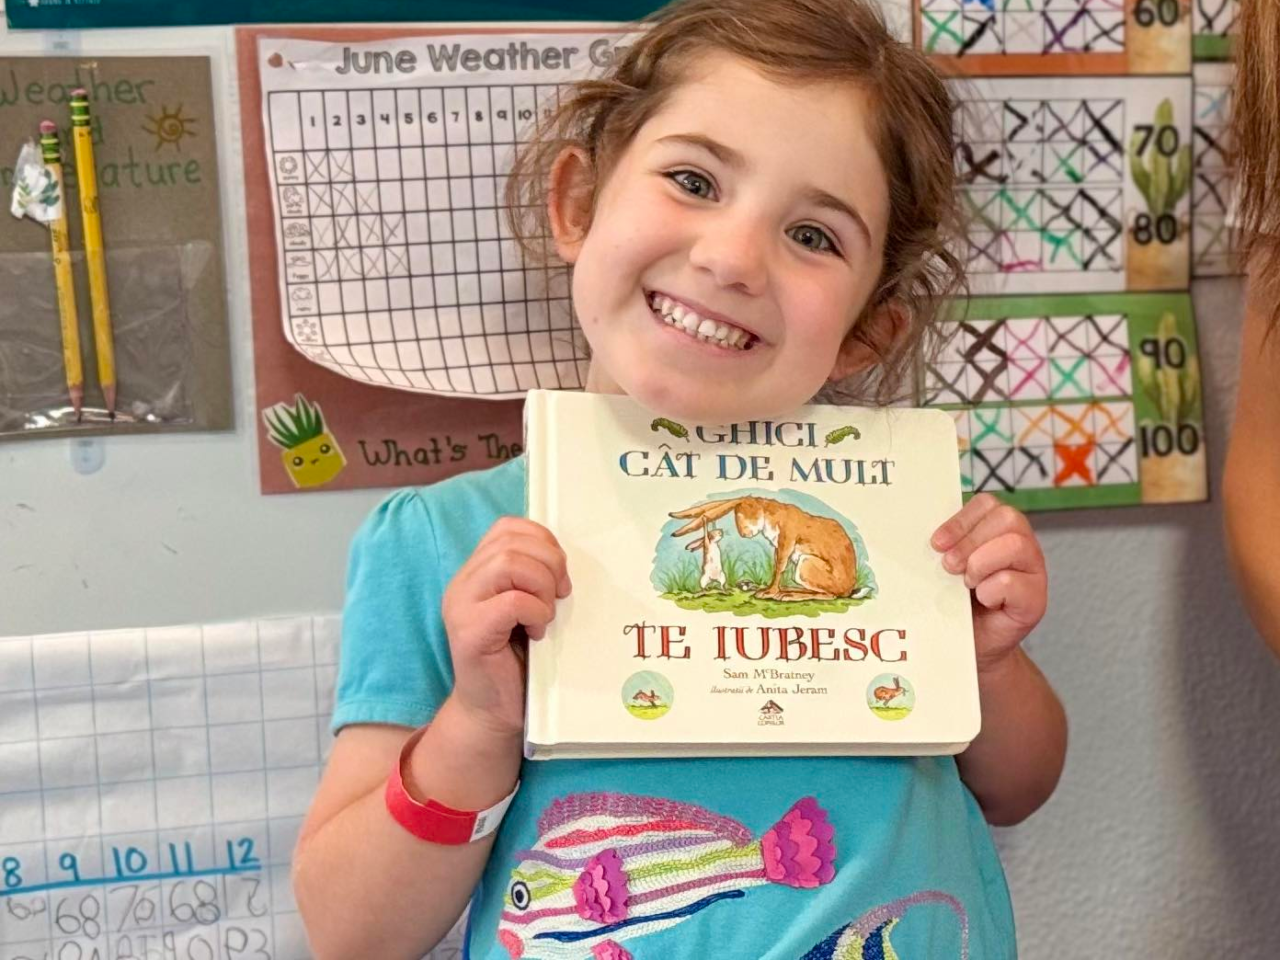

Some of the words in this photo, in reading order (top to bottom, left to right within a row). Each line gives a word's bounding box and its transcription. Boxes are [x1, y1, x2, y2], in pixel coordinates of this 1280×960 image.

[335, 47, 417, 75] June
[427, 41, 580, 73] Weather
[309, 115, 316, 128] 1
[332, 115, 342, 127] 2
[356, 114, 366, 126] 3
[380, 112, 390, 125] 4
[403, 112, 414, 125] 5
[427, 111, 438, 124] 6
[451, 111, 460, 123] 7
[475, 110, 484, 122] 8
[496, 110, 508, 122] 9
[518, 109, 532, 121] 10
[1132, 125, 1180, 157] 70
[1132, 213, 1177, 245] 80
[1139, 337, 1186, 370] 90
[696, 420, 819, 447] GHICI
[1140, 425, 1199, 457] 100
[357, 435, 468, 467] What's
[618, 443, 701, 479] CÂT
[715, 453, 774, 481] DE
[789, 456, 896, 487] MULT
[622, 621, 691, 661] TE
[711, 625, 908, 663] IUBESC
[723, 668, 748, 679] Sam
[753, 667, 815, 683] McBratney
[755, 683, 788, 695] Anita
[791, 683, 829, 695] Jeram
[2, 856, 22, 888] 8
[59, 852, 80, 882] 9
[112, 846, 147, 878] 10
[169, 841, 194, 874] 11
[227, 837, 260, 871] 12
